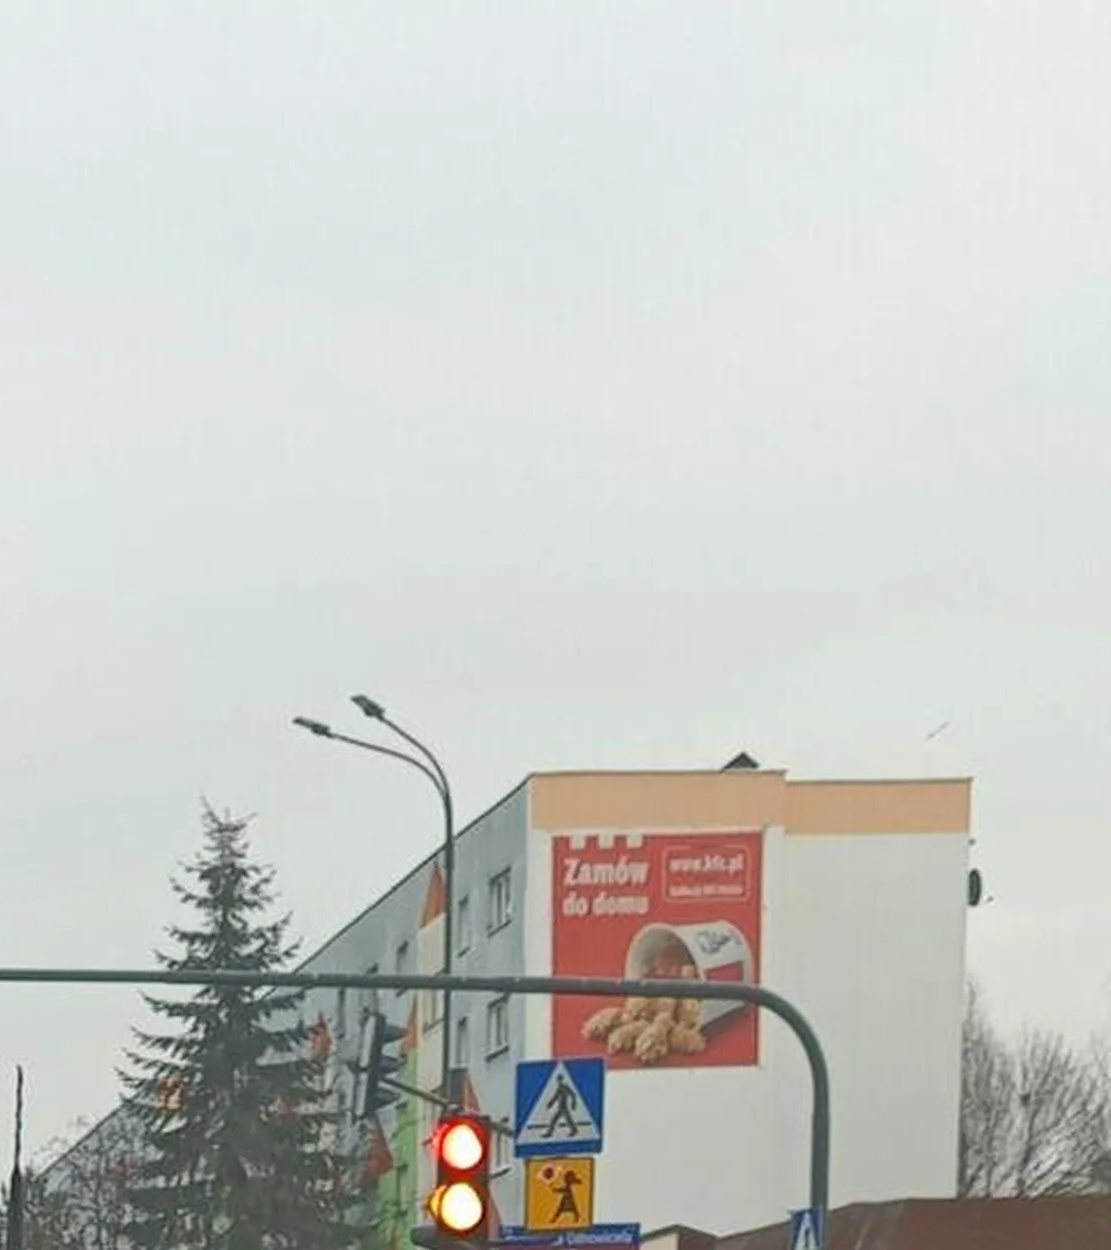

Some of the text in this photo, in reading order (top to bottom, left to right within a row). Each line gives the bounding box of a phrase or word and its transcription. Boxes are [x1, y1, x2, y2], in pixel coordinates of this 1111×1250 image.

[563, 855, 649, 886] Zamów
[563, 891, 649, 916] do domu
